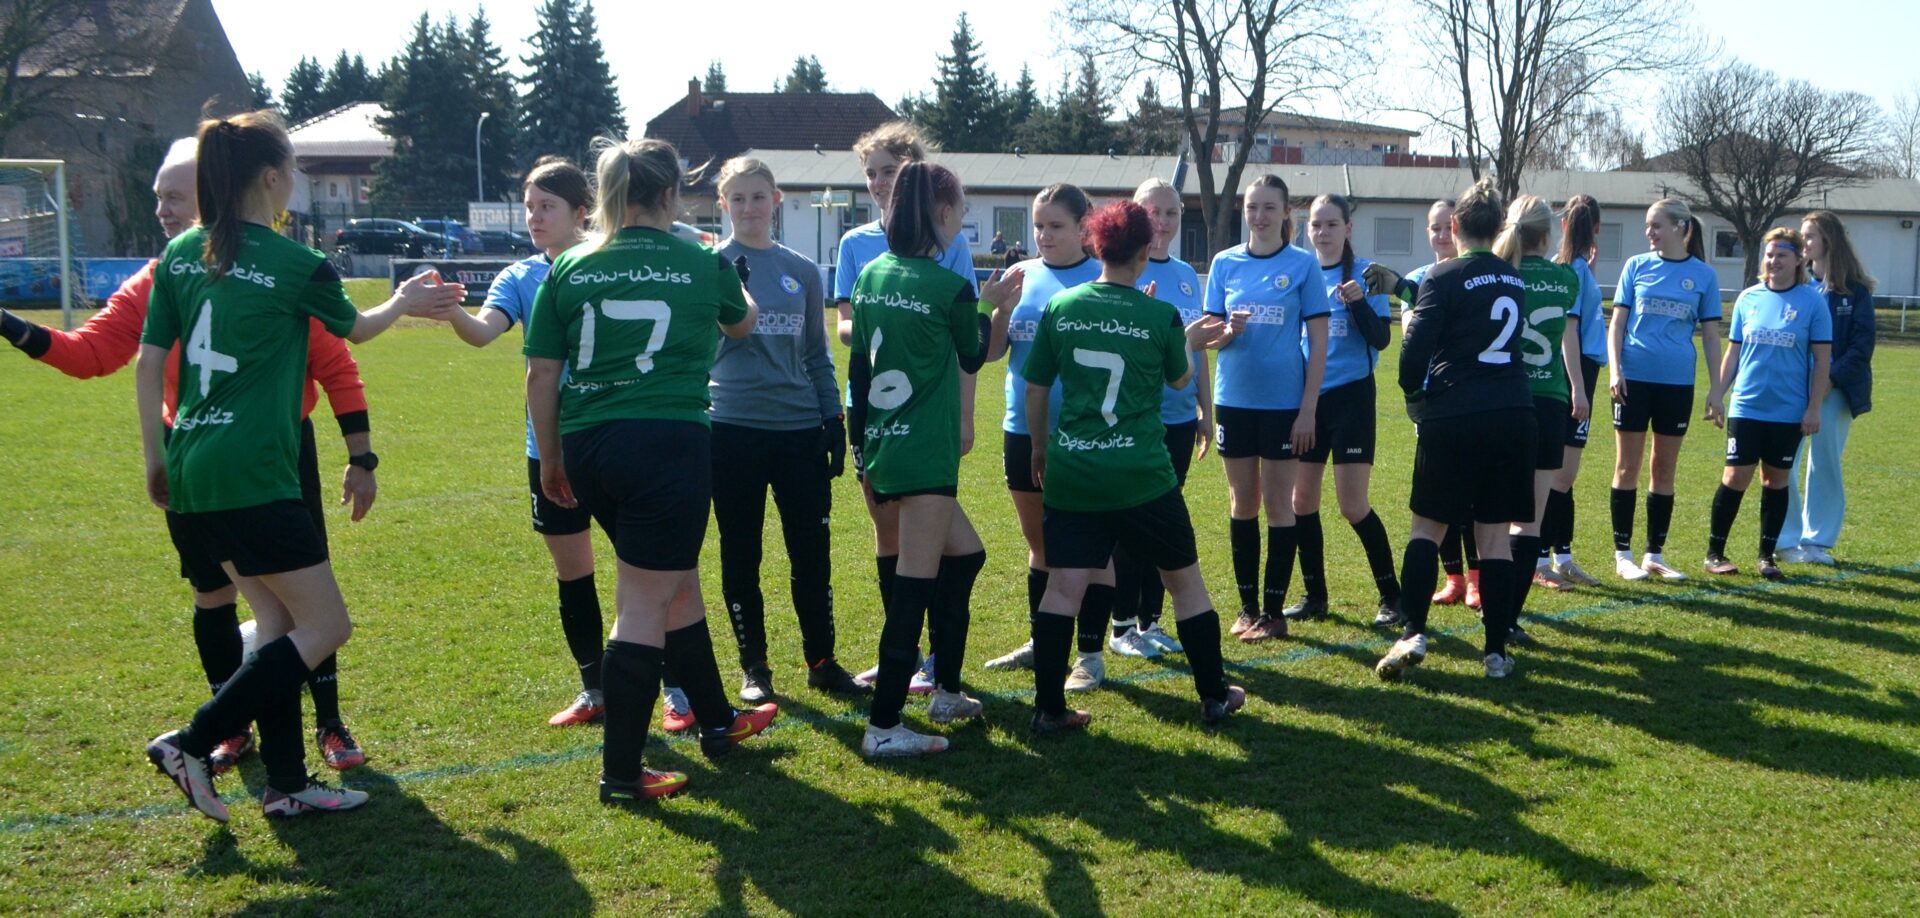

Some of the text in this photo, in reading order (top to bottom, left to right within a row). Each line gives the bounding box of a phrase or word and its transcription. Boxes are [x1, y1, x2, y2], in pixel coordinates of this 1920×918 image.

[569, 264, 692, 285] Grün-Weiss
[186, 299, 239, 399] 4
[576, 299, 672, 374] 17
[1056, 316, 1151, 340] Grün-Weiss
[1478, 296, 1519, 365] 2
[868, 326, 913, 410] 6
[1073, 347, 1125, 428] 7
